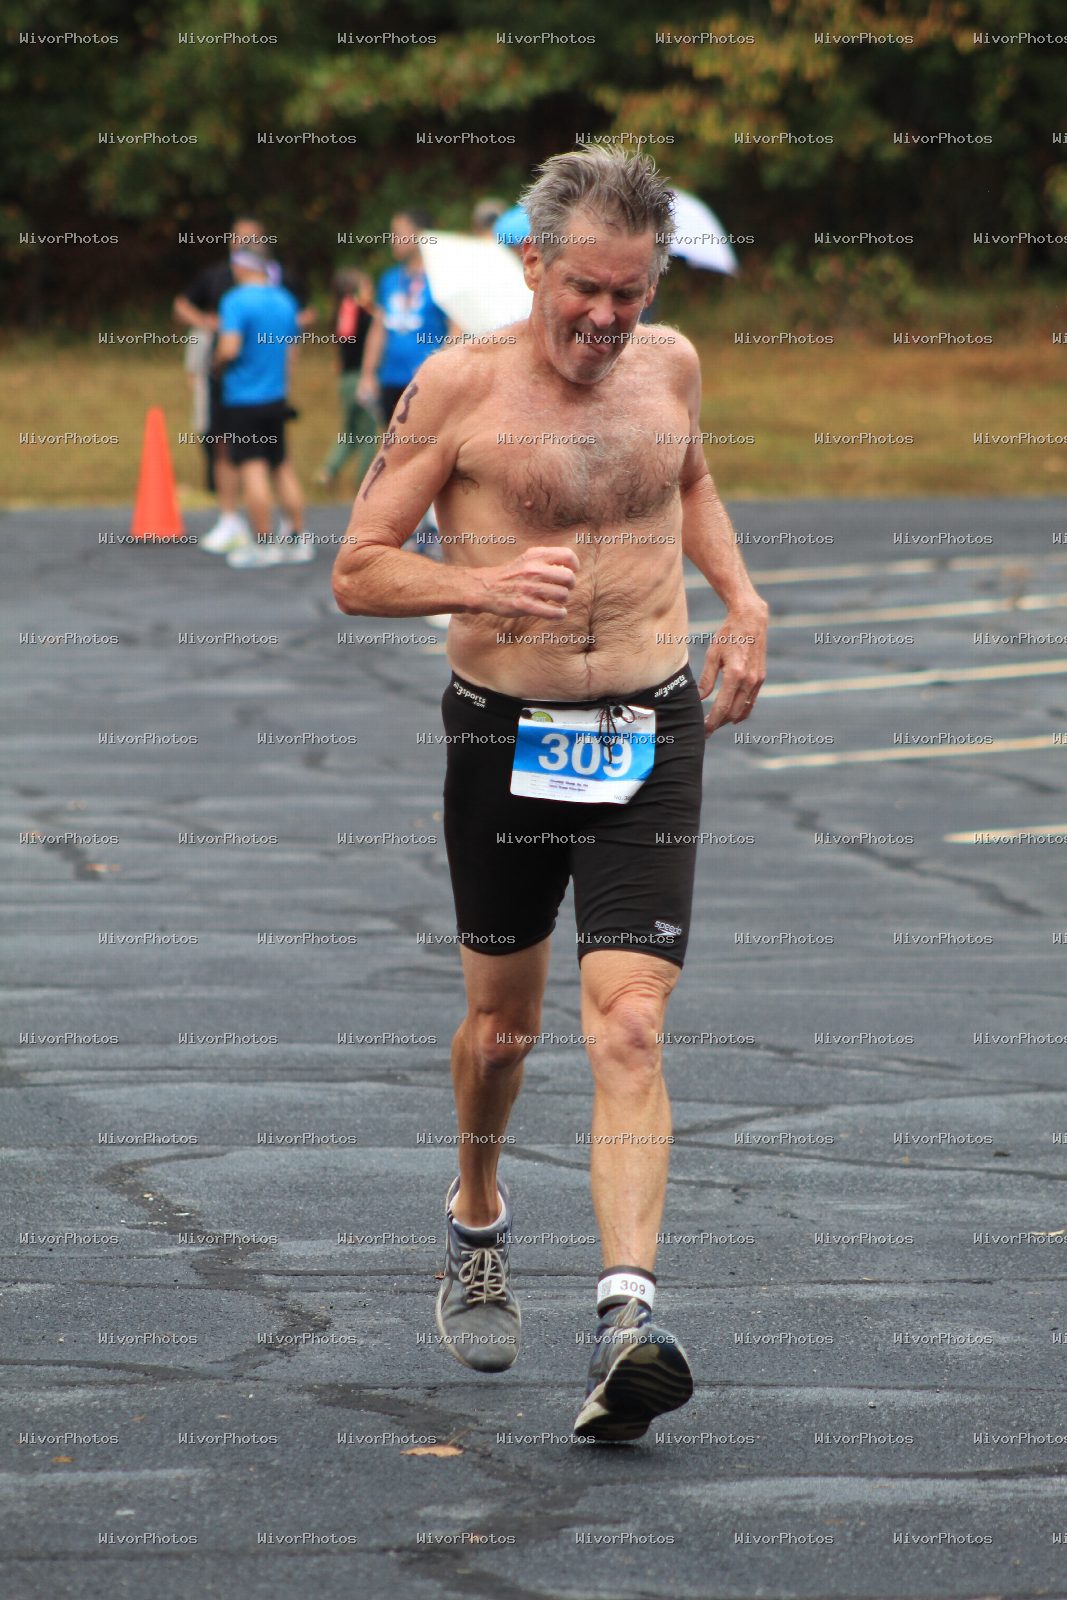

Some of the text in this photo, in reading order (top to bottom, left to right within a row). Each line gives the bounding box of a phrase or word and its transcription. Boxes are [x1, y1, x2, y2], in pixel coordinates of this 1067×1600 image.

[654, 674, 686, 698] all3sports
[538, 732, 633, 778] 309
[619, 1279, 647, 1296] 309
